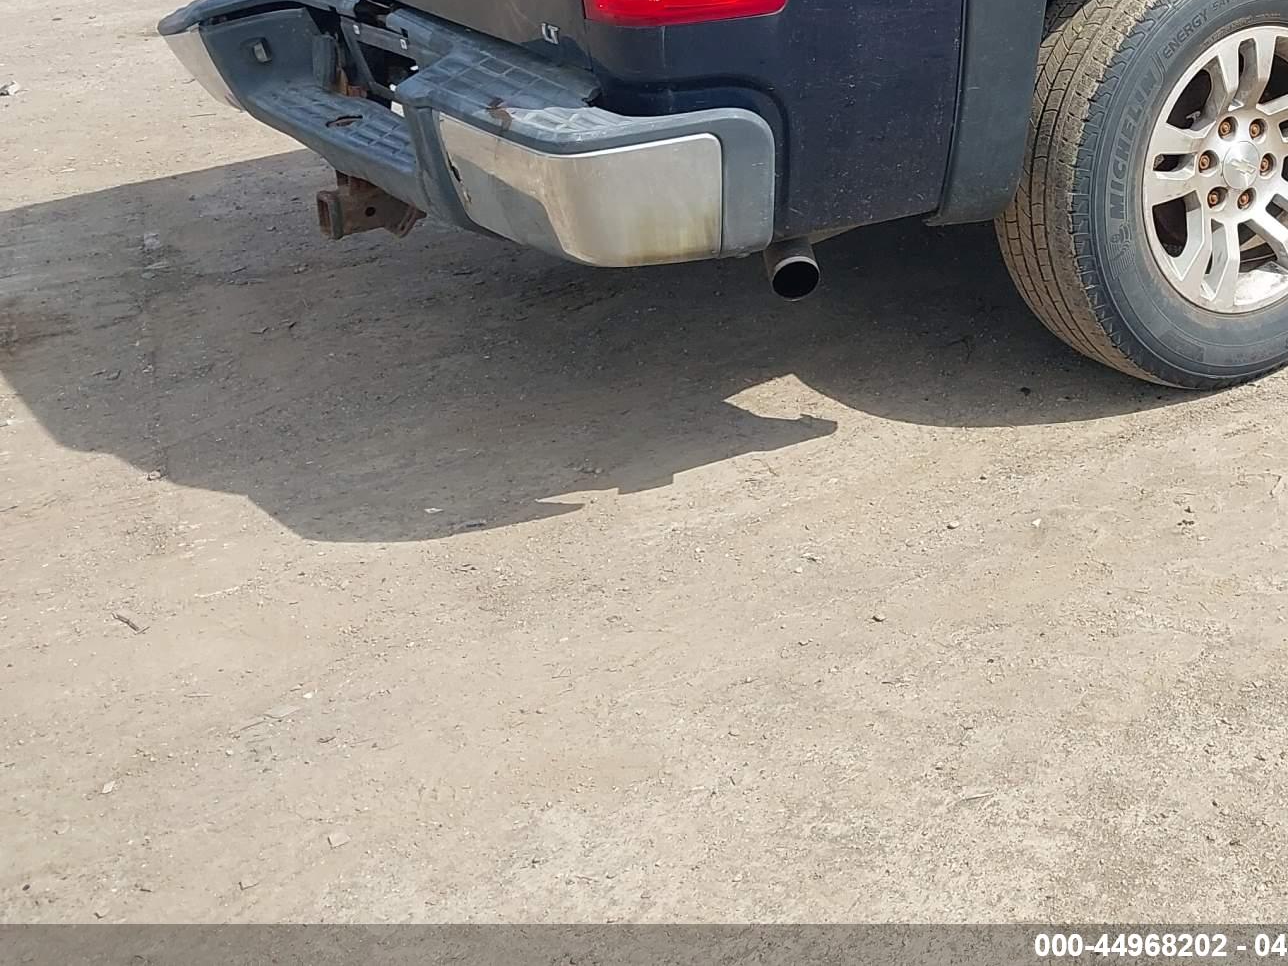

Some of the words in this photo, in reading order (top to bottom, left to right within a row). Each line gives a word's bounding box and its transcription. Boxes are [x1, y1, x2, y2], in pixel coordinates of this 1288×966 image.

[541, 22, 560, 45] LT
[1162, 8, 1207, 59] ENERGY
[1109, 70, 1157, 220] MICHELIN
